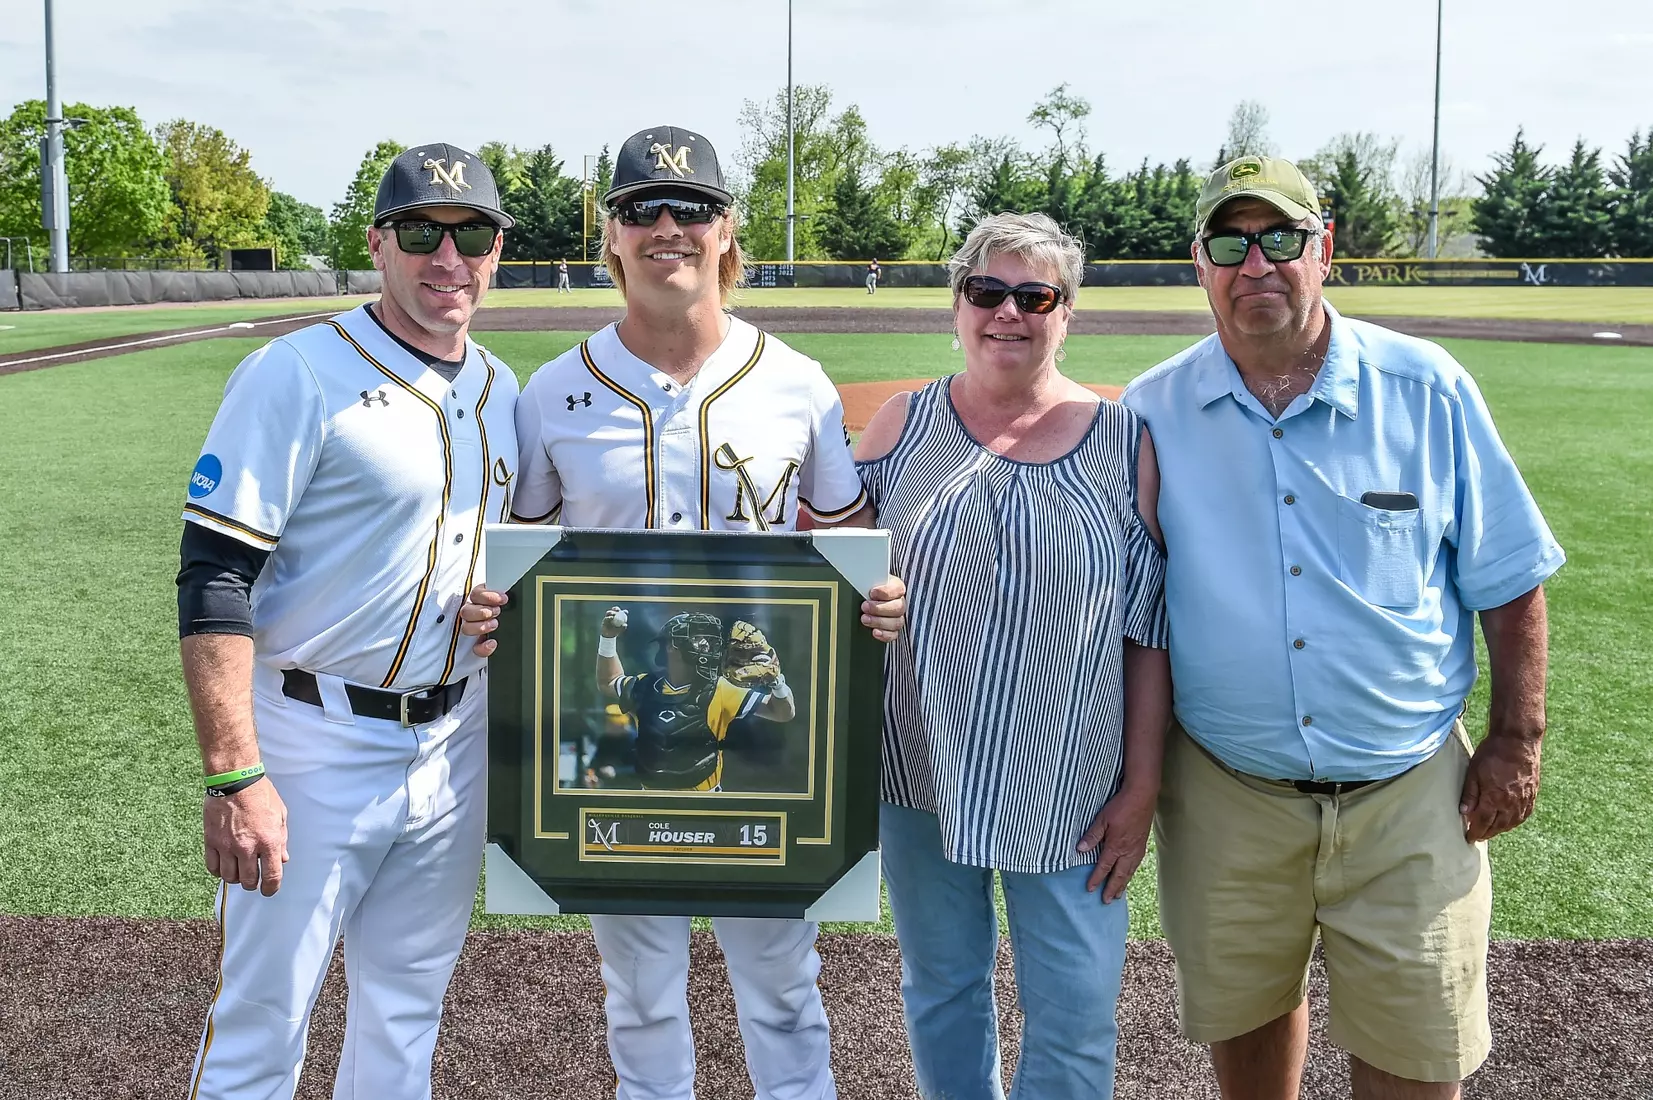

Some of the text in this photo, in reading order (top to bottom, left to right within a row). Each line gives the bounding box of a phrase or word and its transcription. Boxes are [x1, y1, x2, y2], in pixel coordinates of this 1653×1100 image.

[1352, 264, 1429, 285] PARK
[191, 471, 216, 492] NCAA
[648, 822, 670, 830] COLE
[739, 824, 768, 846] 15
[648, 831, 716, 844] HOUSER
